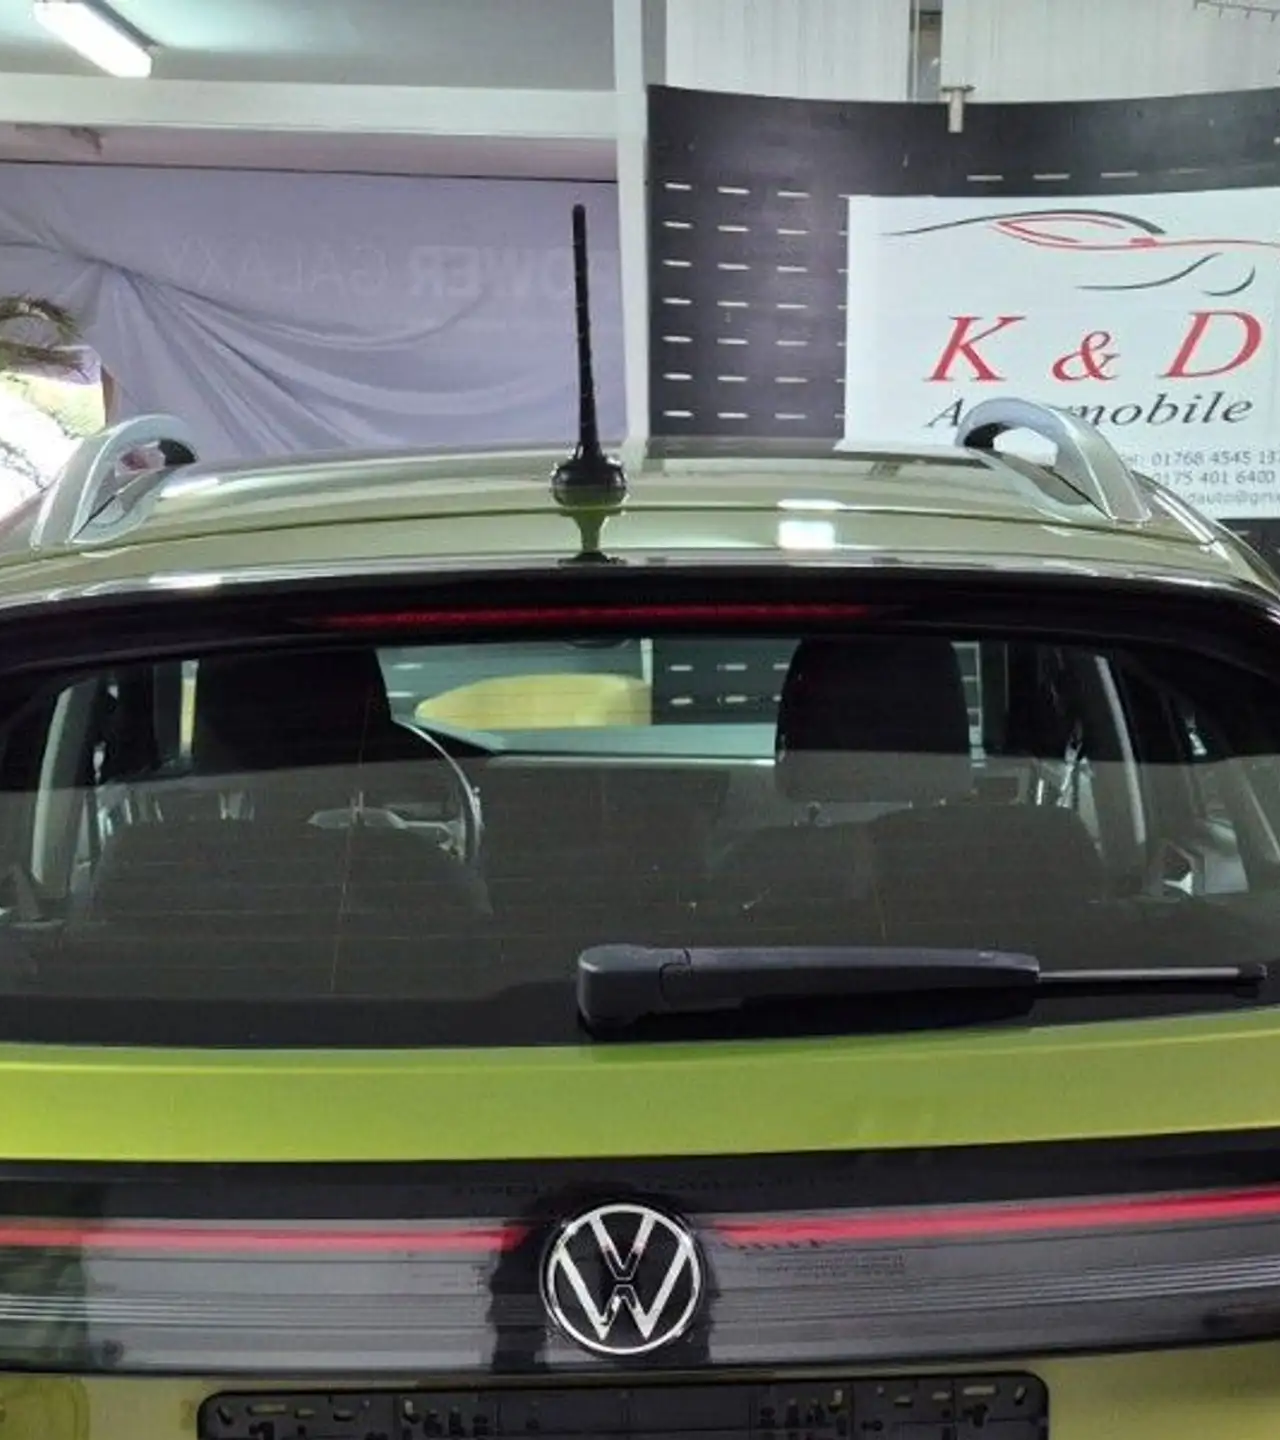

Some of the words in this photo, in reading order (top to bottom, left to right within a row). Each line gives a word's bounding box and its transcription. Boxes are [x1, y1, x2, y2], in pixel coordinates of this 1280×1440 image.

[923, 315, 1026, 381] K
[1051, 330, 1120, 381] &
[1155, 310, 1263, 378] D
[924, 391, 1254, 428] Amobile
